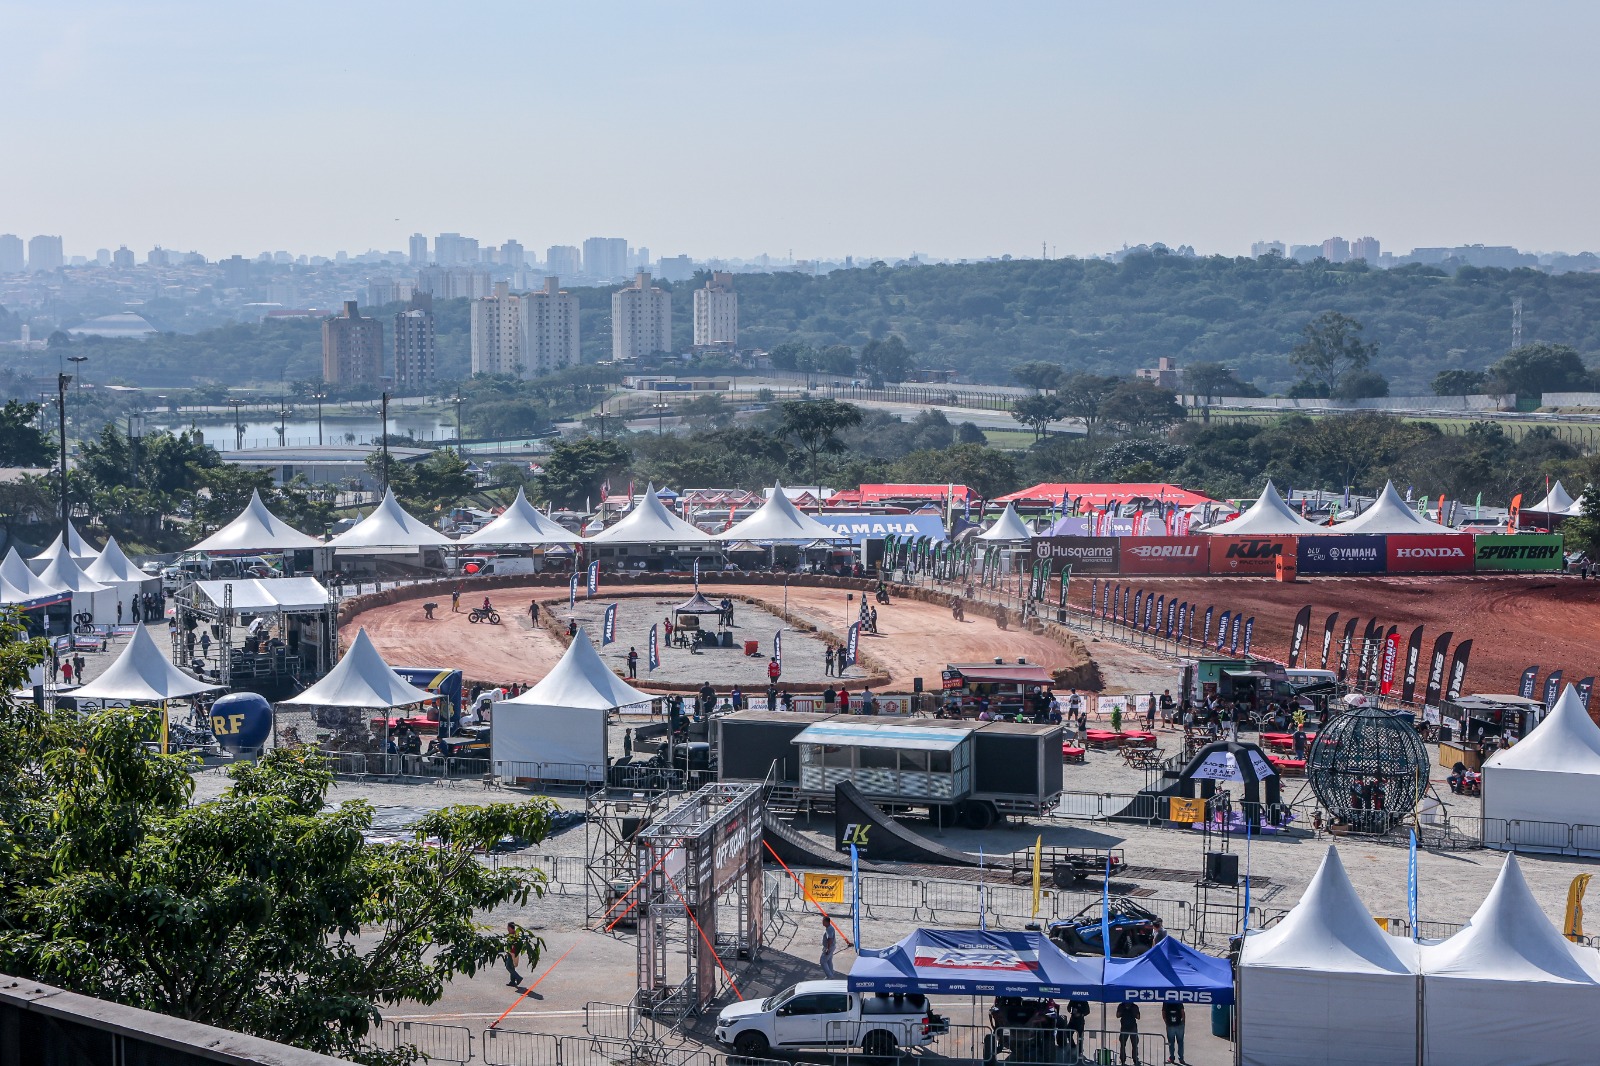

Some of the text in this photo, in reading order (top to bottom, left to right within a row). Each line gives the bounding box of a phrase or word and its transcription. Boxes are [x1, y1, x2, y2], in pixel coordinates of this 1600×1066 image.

[1052, 545, 1113, 558] Husqvarna
[1139, 545, 1199, 557] BORILLI
[1226, 540, 1283, 558] KTM
[1340, 548, 1377, 557] YAMAHA
[1396, 547, 1465, 558] HONDA
[1476, 545, 1559, 559] SPORTBAY
[1383, 638, 1395, 682] CIGANO
[842, 823, 872, 841] FK
[715, 839, 730, 869] OFF
[729, 826, 747, 859] ROAD
[1125, 989, 1213, 1003] POLARIS
